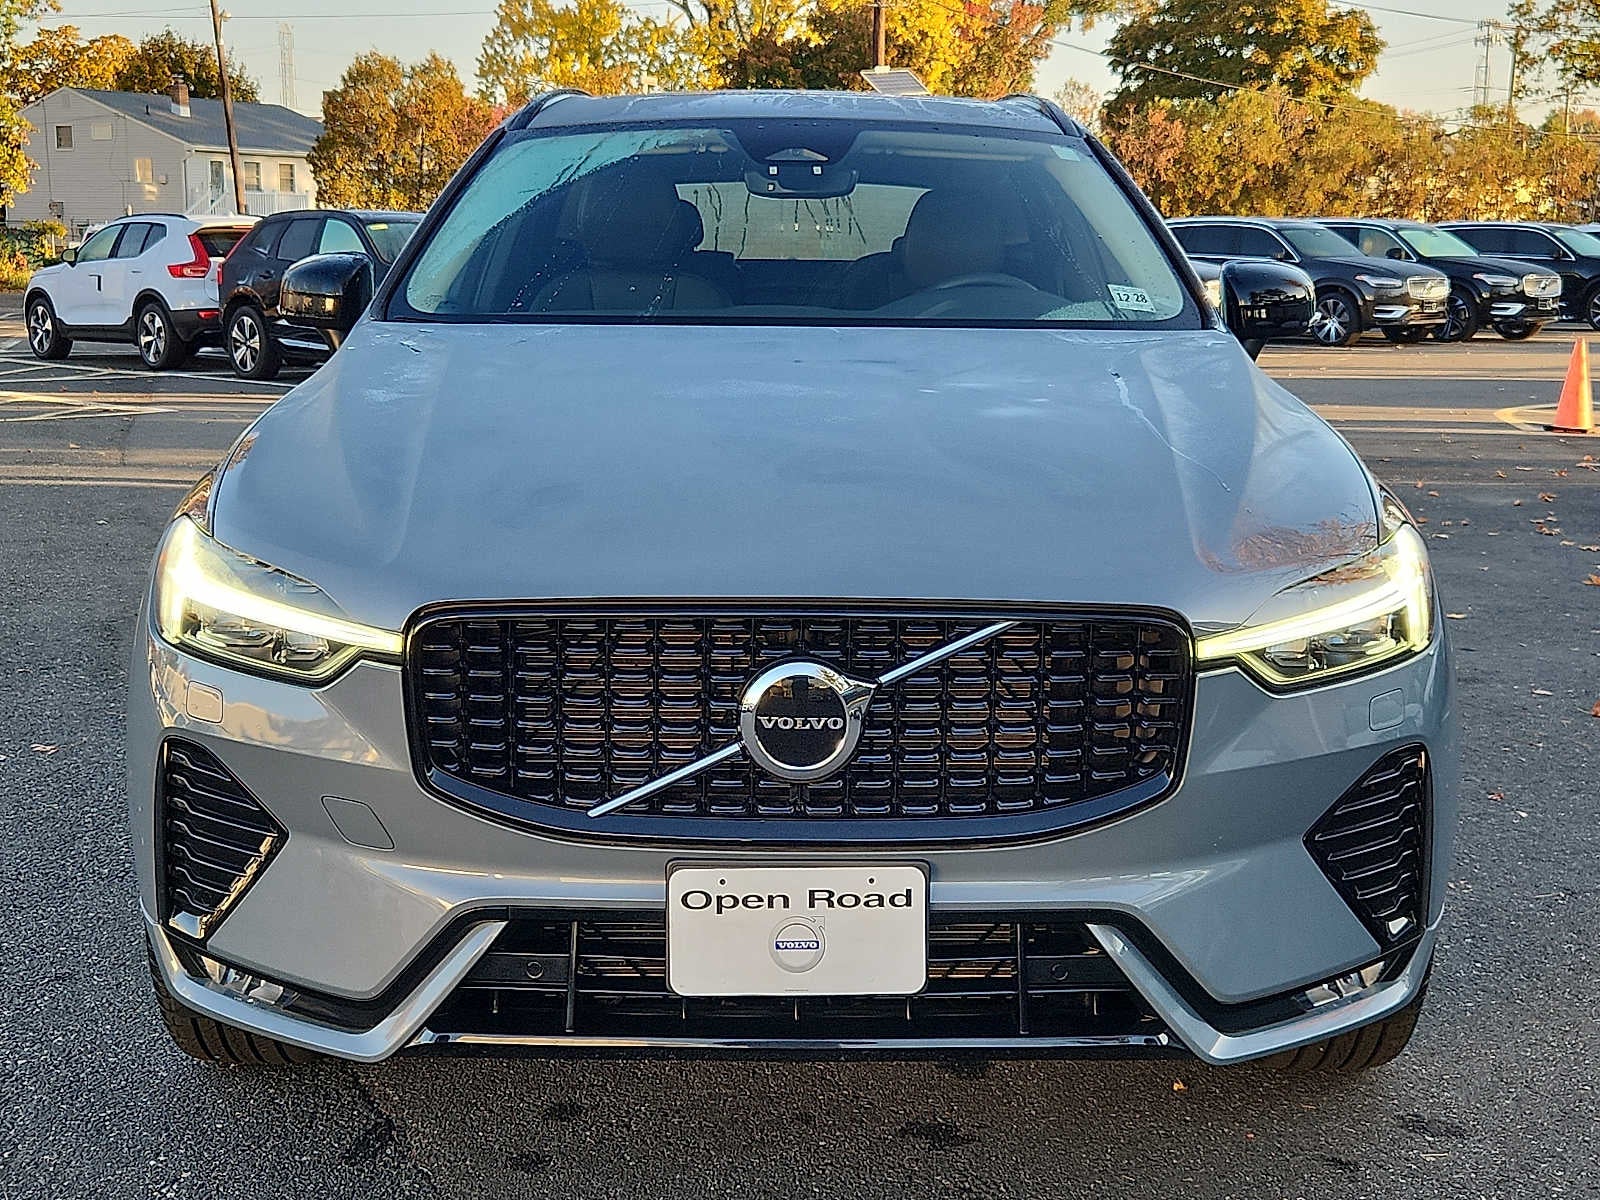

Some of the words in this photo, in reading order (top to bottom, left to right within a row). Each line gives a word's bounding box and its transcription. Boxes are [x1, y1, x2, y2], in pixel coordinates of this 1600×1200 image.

[1116, 292, 1130, 302] 12
[1133, 293, 1147, 303] 28
[757, 715, 844, 730] VOLVO
[680, 890, 790, 914] Open
[808, 888, 912, 909] Road
[776, 941, 818, 949] VOLVO
